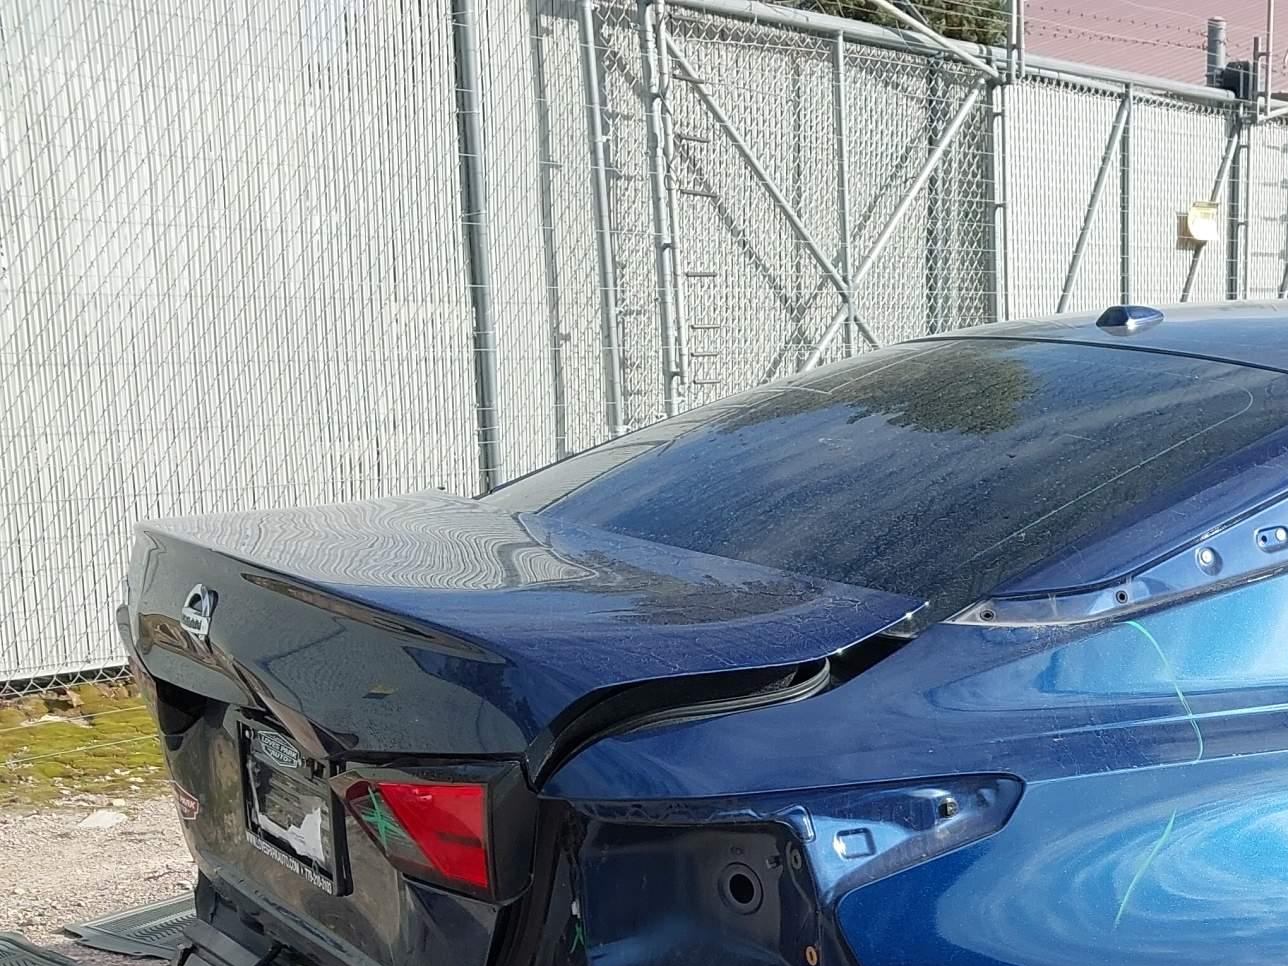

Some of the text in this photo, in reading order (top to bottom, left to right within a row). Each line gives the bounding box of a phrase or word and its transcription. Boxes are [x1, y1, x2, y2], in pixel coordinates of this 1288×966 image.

[261, 735, 297, 759] LOVES PARK
[271, 751, 289, 762] AUTO
